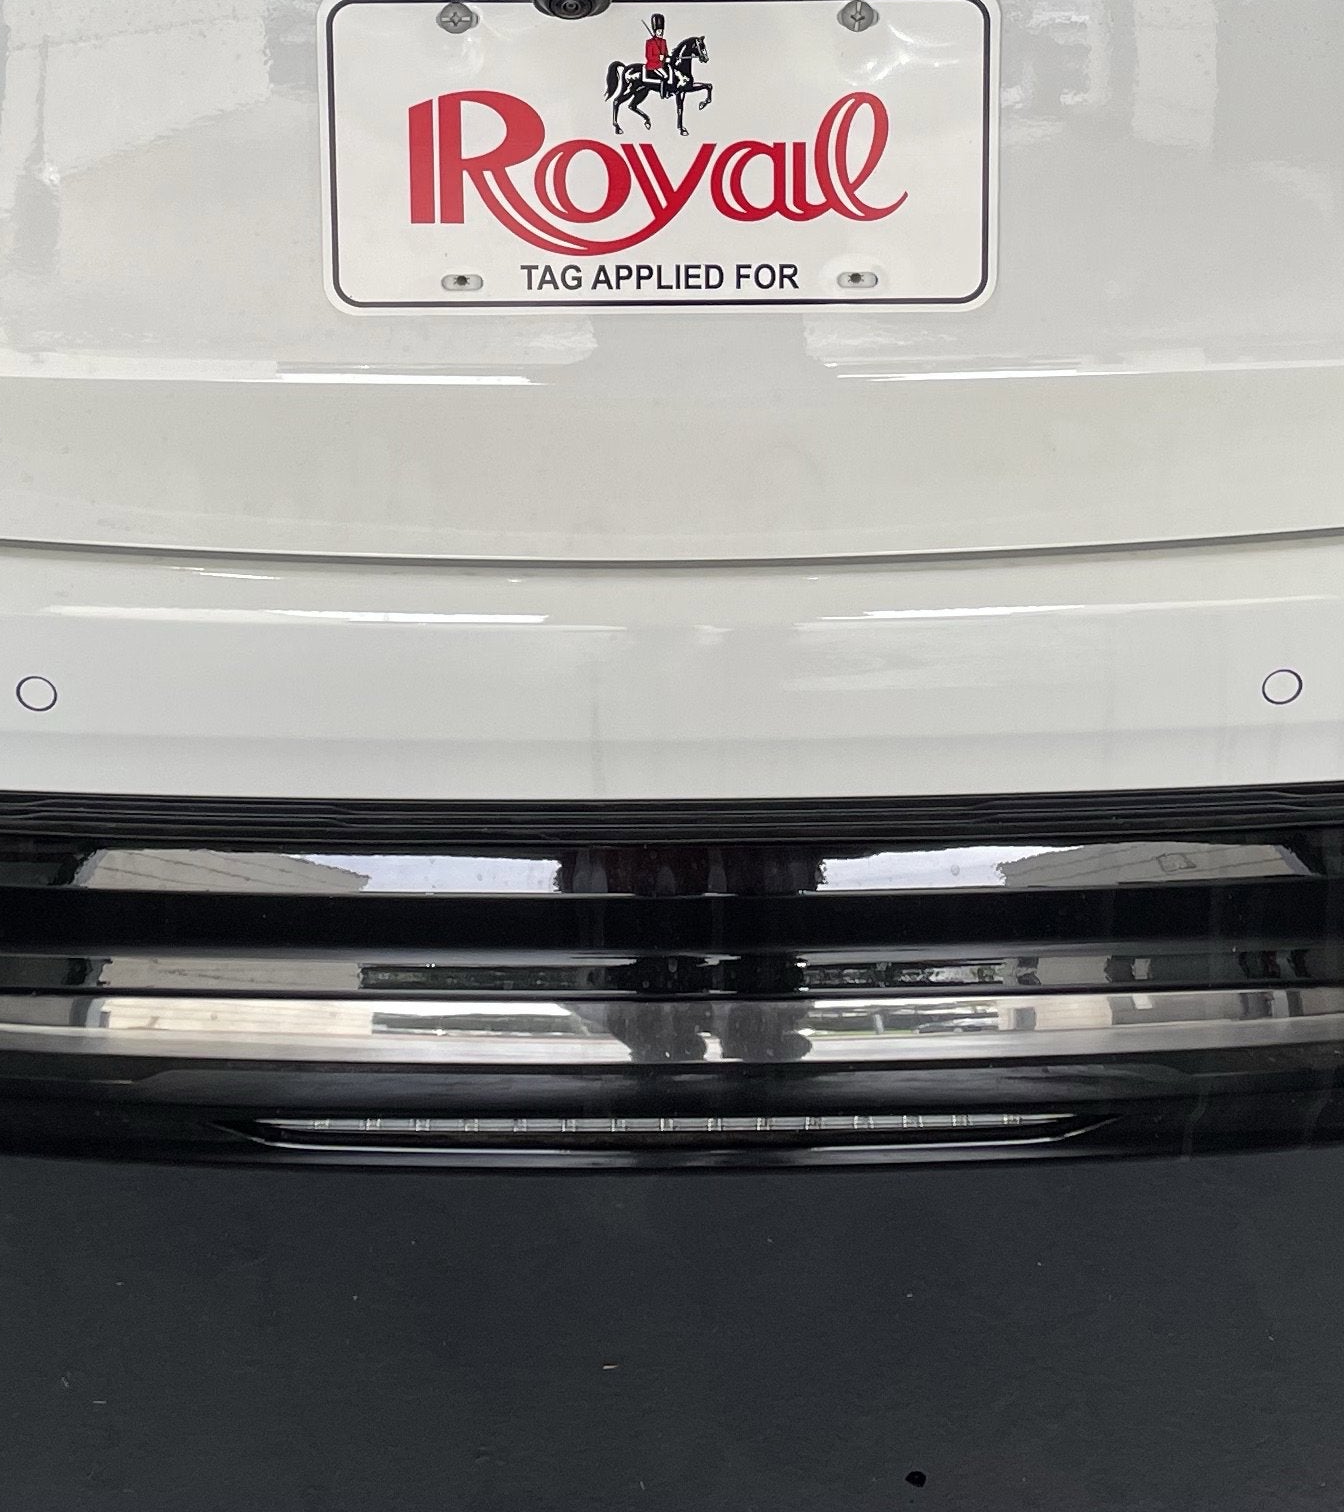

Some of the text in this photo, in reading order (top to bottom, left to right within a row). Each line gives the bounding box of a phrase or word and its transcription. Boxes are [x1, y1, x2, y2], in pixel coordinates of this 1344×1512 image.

[407, 89, 909, 257] Royal
[519, 262, 800, 291] TAG APPLIED FOR
